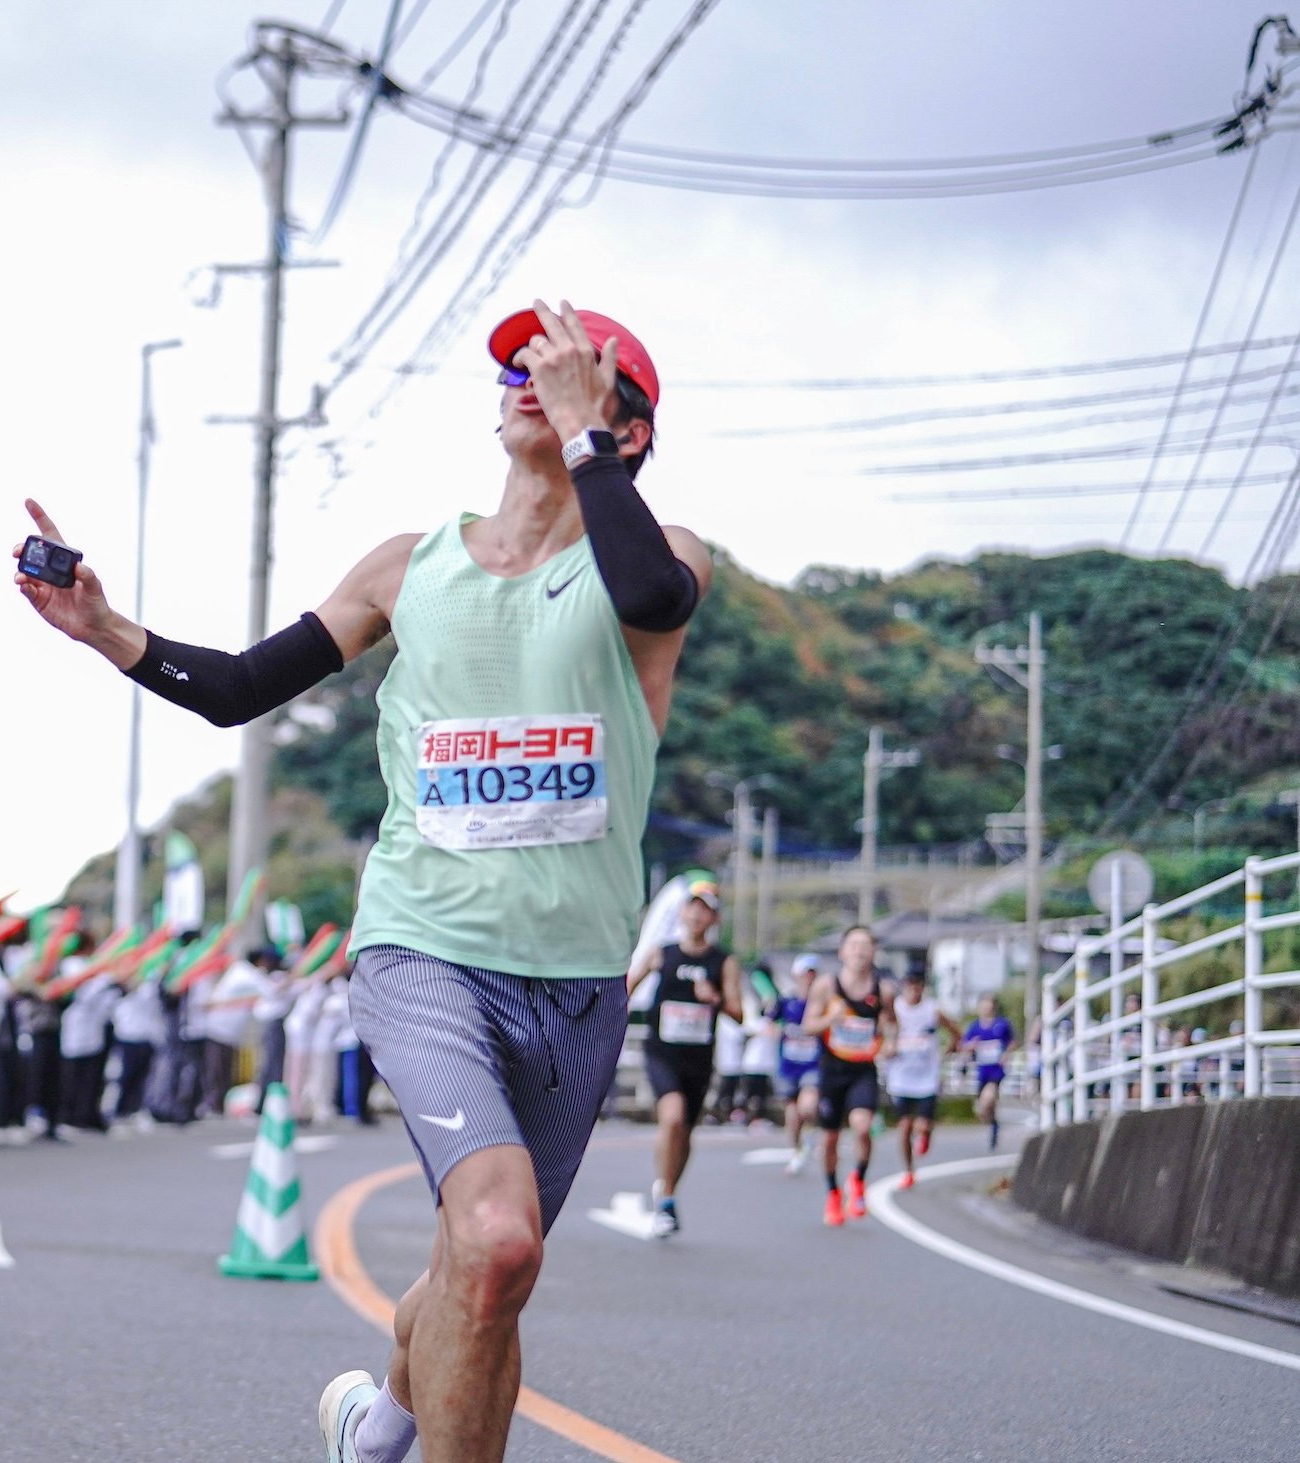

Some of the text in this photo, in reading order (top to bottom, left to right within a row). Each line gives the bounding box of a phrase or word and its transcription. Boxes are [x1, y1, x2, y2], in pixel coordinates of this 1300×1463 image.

[423, 727, 594, 763] 福岡トヨタ
[422, 783, 445, 806] A
[453, 763, 596, 804] 10349
